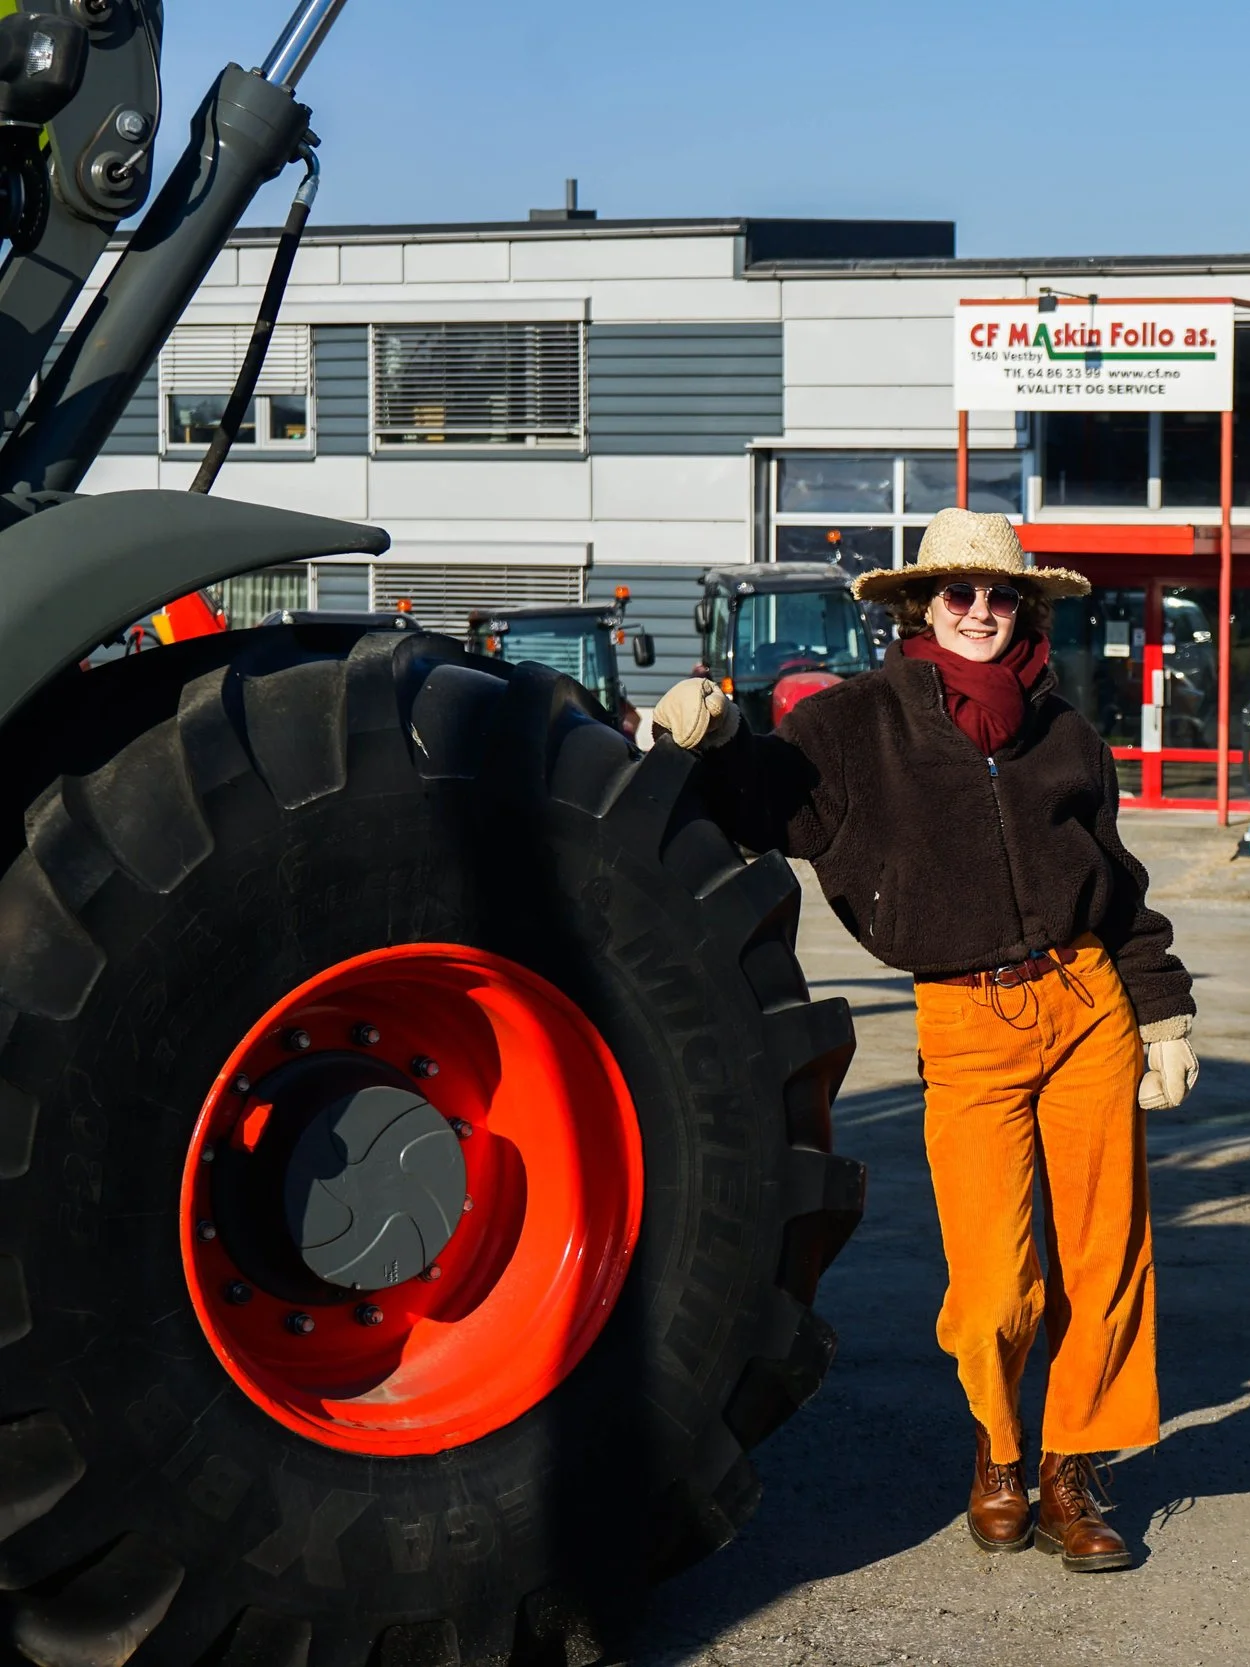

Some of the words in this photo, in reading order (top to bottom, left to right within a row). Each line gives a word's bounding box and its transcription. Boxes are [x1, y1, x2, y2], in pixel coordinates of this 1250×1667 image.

[970, 322, 1000, 347] CF
[1110, 322, 1174, 347] Follo
[1183, 327, 1217, 347] as.
[970, 351, 999, 361] 1540
[1002, 351, 1043, 363] Vestby
[1027, 367, 1044, 379] 64
[1065, 367, 1082, 379] 33
[1108, 368, 1181, 379] www.cf.no
[1017, 384, 1082, 395] KVALITET
[1085, 384, 1105, 395] OG
[1107, 384, 1167, 395] SERVICE
